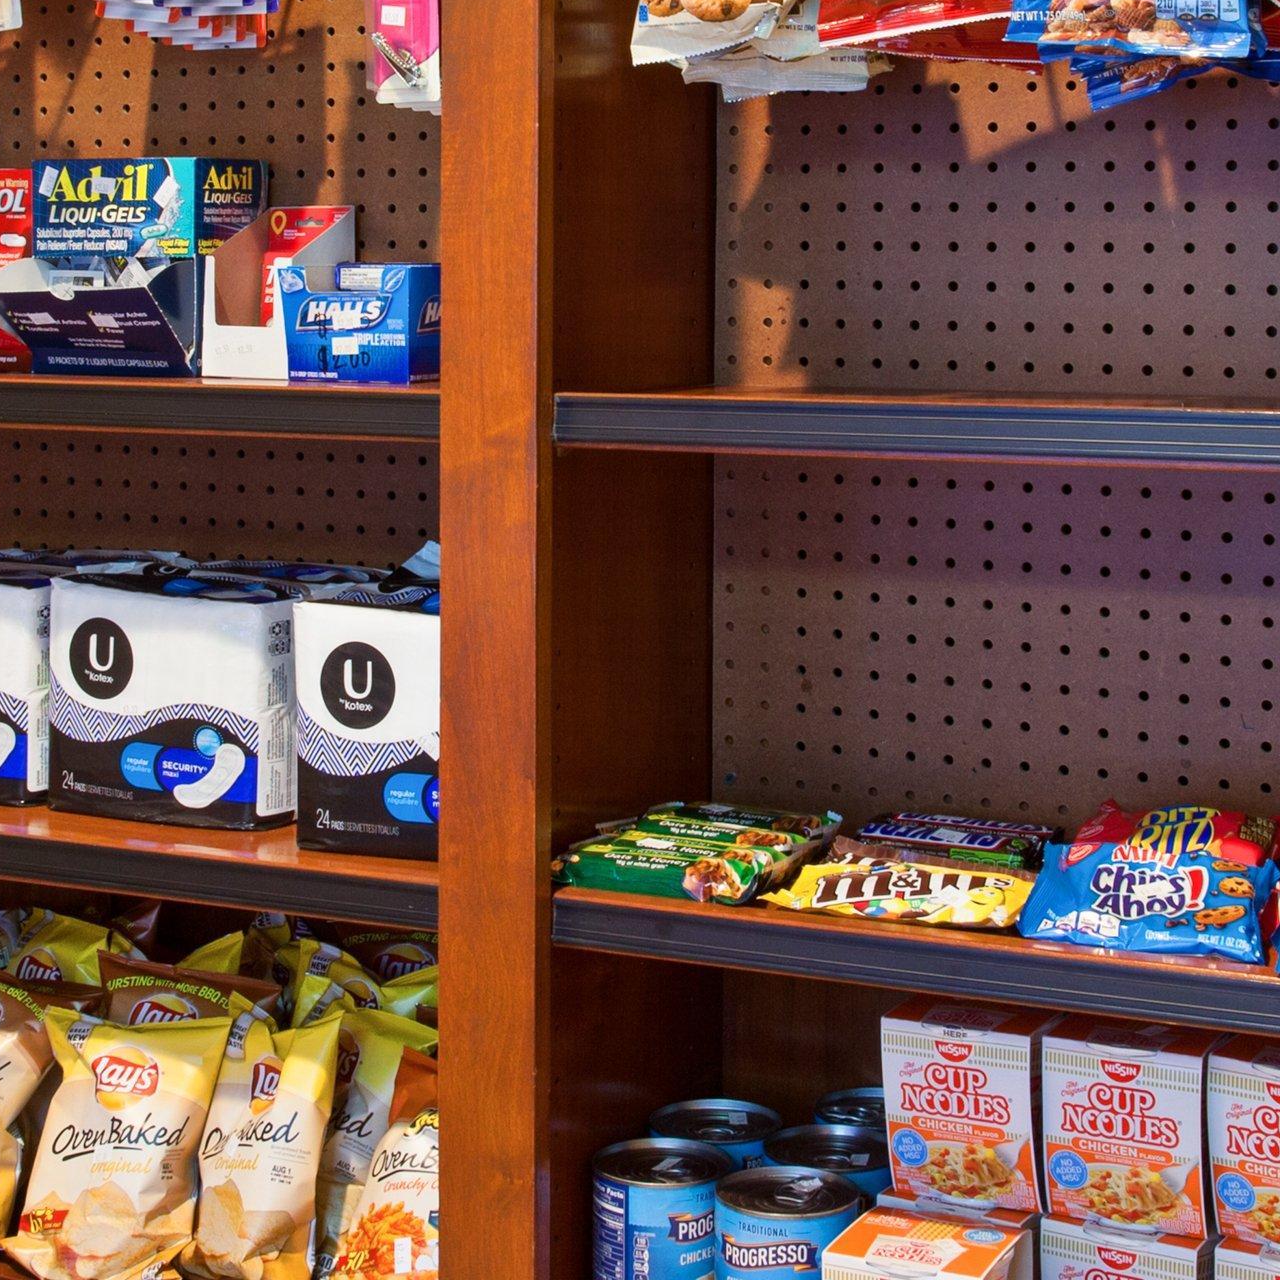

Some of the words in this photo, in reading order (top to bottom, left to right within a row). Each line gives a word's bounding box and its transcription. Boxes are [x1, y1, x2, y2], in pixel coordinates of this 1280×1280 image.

[48, 165, 150, 202] Advil
[203, 166, 253, 191] Advil
[89, 633, 114, 671] U
[343, 659, 373, 699] U
[345, 699, 373, 712] Kotex
[127, 757, 149, 766] regular
[162, 760, 205, 774] SECURITY
[62, 770, 74, 789] 24
[162, 770, 179, 778] maxi
[390, 789, 415, 798] regular
[316, 808, 330, 829] 24
[1128, 819, 1213, 854] RITZ
[650, 857, 689, 866] Honey
[156, 978, 175, 988] WITH
[176, 983, 199, 995] MORE
[198, 986, 221, 1002] BBQ
[938, 1044, 969, 1057] NISSIN
[96, 1057, 157, 1093] Lay's
[924, 1063, 987, 1095] CUP
[1104, 1062, 1138, 1076] NISSIN
[901, 1084, 1010, 1125] NOODLES
[1087, 1083, 1155, 1114] CUP
[52, 1124, 109, 1155] Oven
[109, 1112, 190, 1147] Baked
[918, 1118, 973, 1134] CHICKEN
[1062, 1103, 1179, 1148] NOODLES
[1079, 1139, 1138, 1157] CHICKEN
[372, 1149, 418, 1177] Oven
[738, 1221, 788, 1237] TRADITIONAL
[725, 1243, 808, 1268] PROGRESSO
[1101, 1251, 1133, 1265] NISSIN
